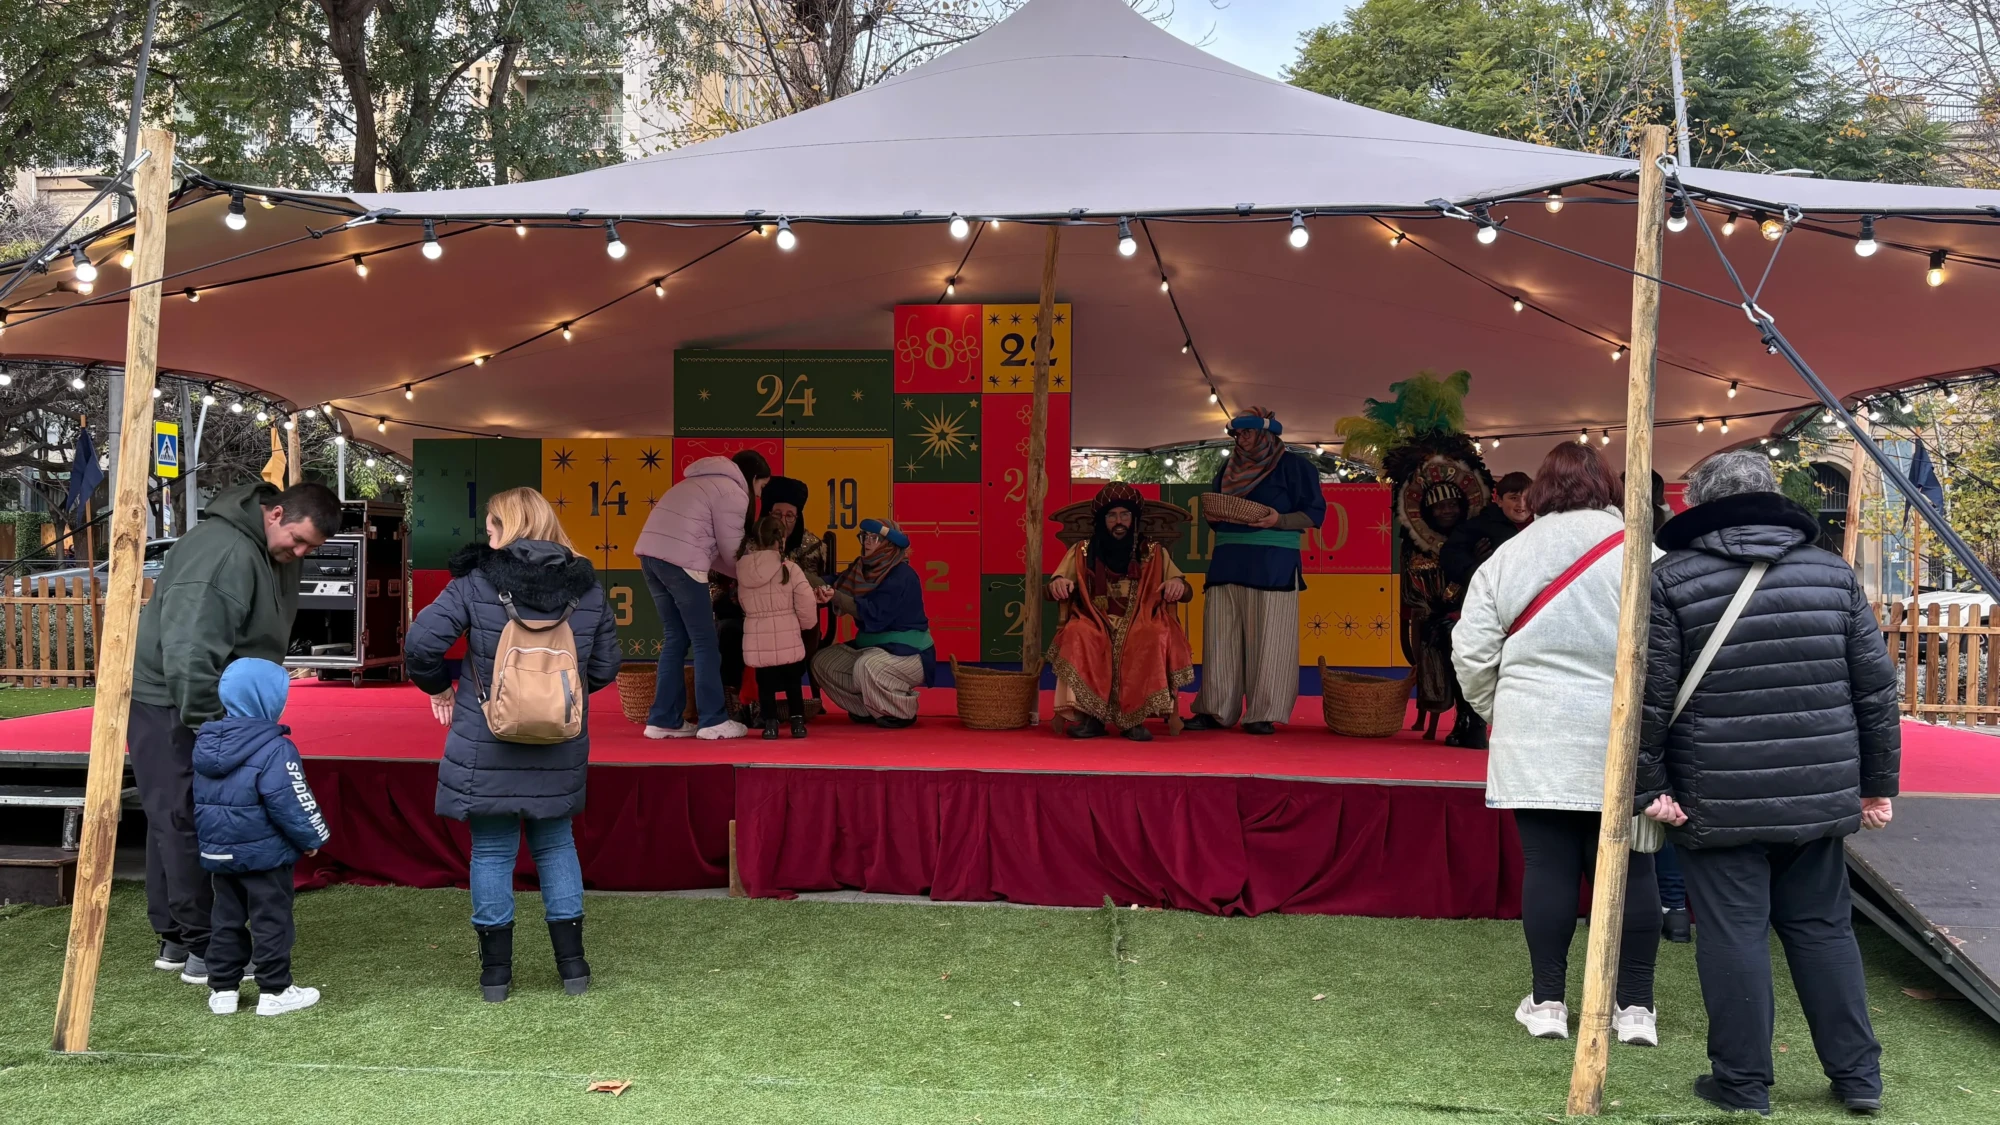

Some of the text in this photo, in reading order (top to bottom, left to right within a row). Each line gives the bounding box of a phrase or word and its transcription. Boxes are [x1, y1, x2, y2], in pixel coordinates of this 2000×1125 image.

[925, 326, 955, 370] 8
[755, 374, 817, 418] 24
[588, 480, 629, 516] 14
[827, 478, 858, 530] 19
[1004, 467, 1049, 502] 2
[925, 560, 950, 592] 2
[285, 761, 331, 842] SPIDER-MAN
